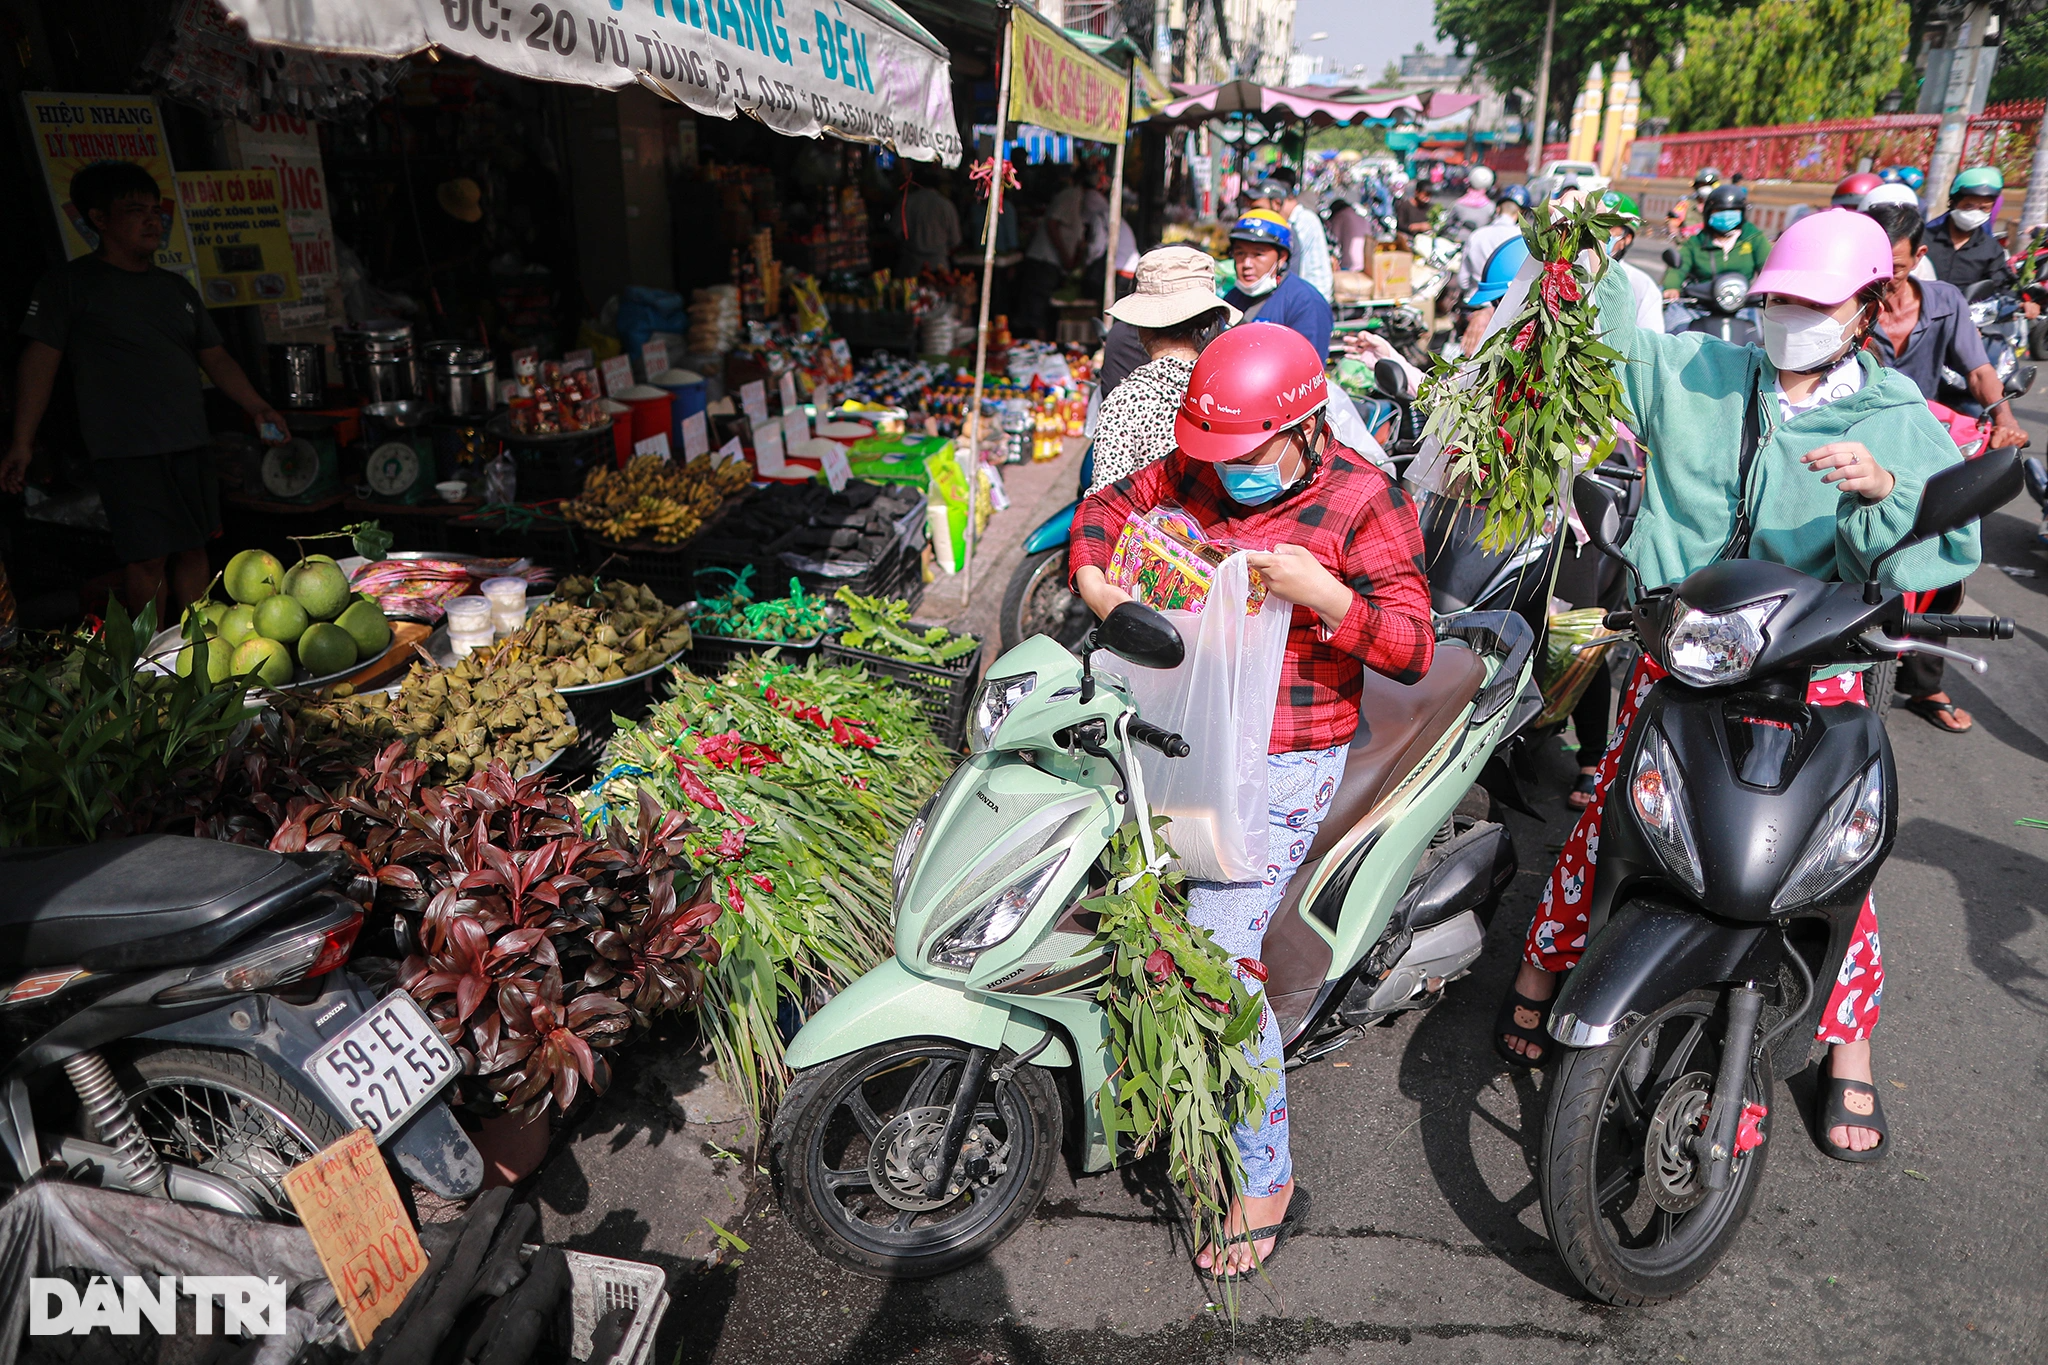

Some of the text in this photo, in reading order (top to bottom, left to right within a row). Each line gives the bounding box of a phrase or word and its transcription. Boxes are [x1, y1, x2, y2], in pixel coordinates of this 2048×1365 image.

[526, 3, 577, 56] 20
[587, 16, 630, 68] VŨ
[634, 30, 709, 89] TÙNG
[814, 1, 875, 95] ĐÈN
[36, 101, 153, 128] HIỆU NHANG
[44, 126, 66, 157] LÝ
[117, 127, 157, 157] PHÁT
[227, 174, 245, 201] CÓ
[247, 173, 275, 200] BÁN
[225, 204, 254, 217] XÔNG
[213, 220, 250, 231] PHONG
[253, 219, 281, 229] LONG
[976, 790, 999, 813] HONDA
[986, 968, 1026, 989] HONDA
[315, 1002, 348, 1028] HONDA
[326, 1008, 414, 1088] 59-E1
[351, 1035, 450, 1135] 627.55
[341, 1225, 420, 1313] 15000
